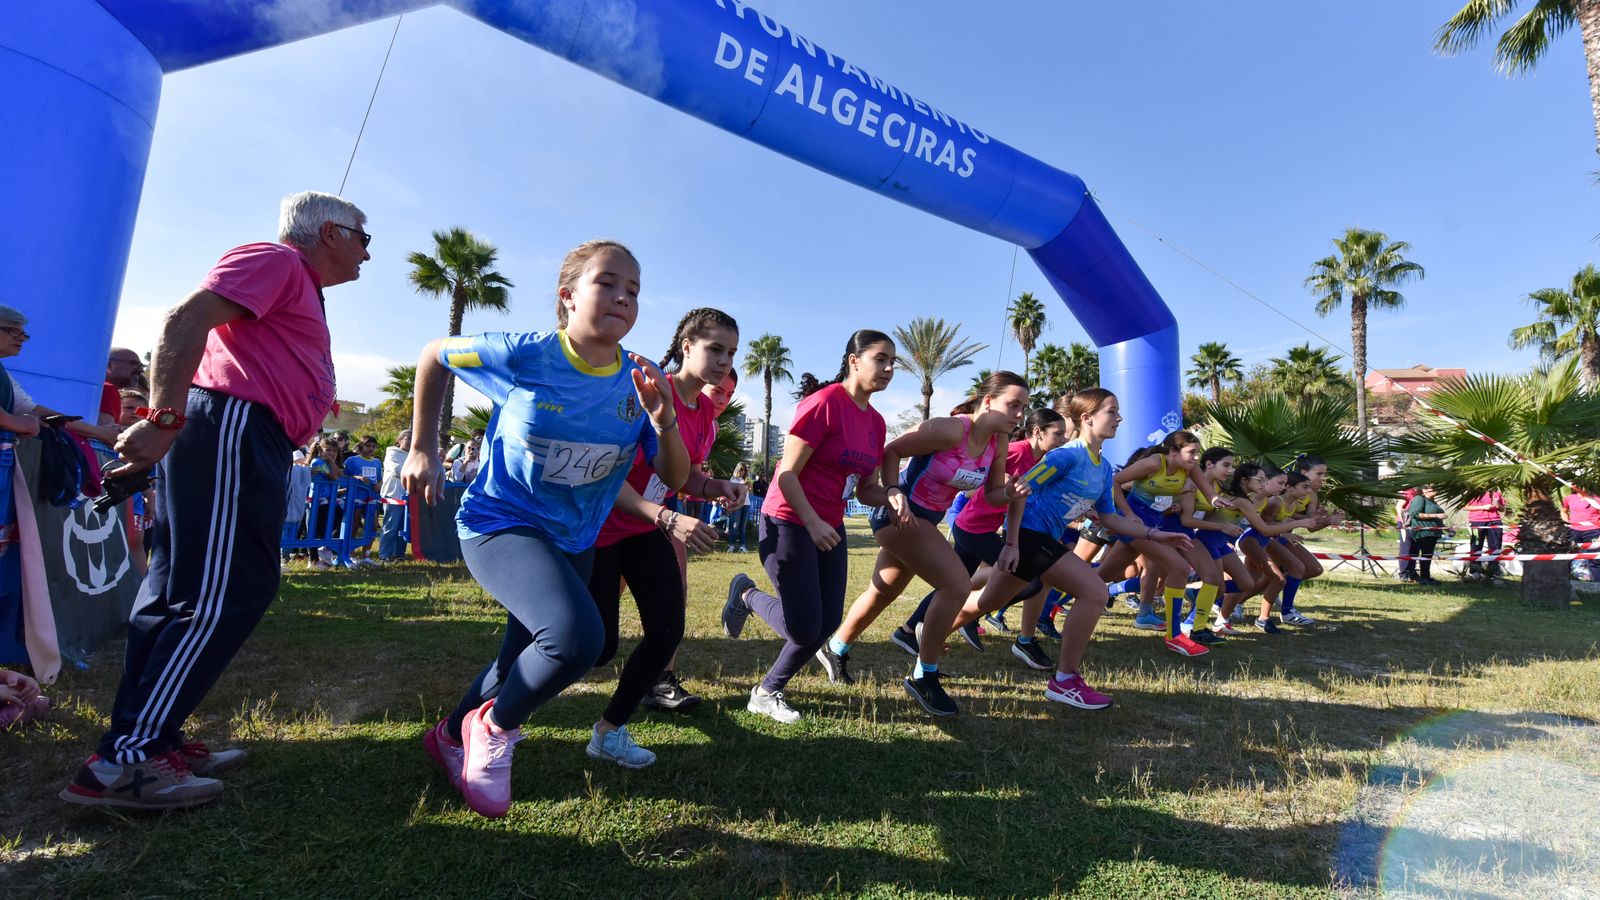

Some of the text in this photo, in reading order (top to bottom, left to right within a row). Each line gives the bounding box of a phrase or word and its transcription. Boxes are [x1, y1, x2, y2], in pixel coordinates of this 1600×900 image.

[714, 0, 990, 144] YUNTAMIENTO
[714, 31, 977, 178] DE ALGECIRAS
[548, 447, 612, 479] 246
